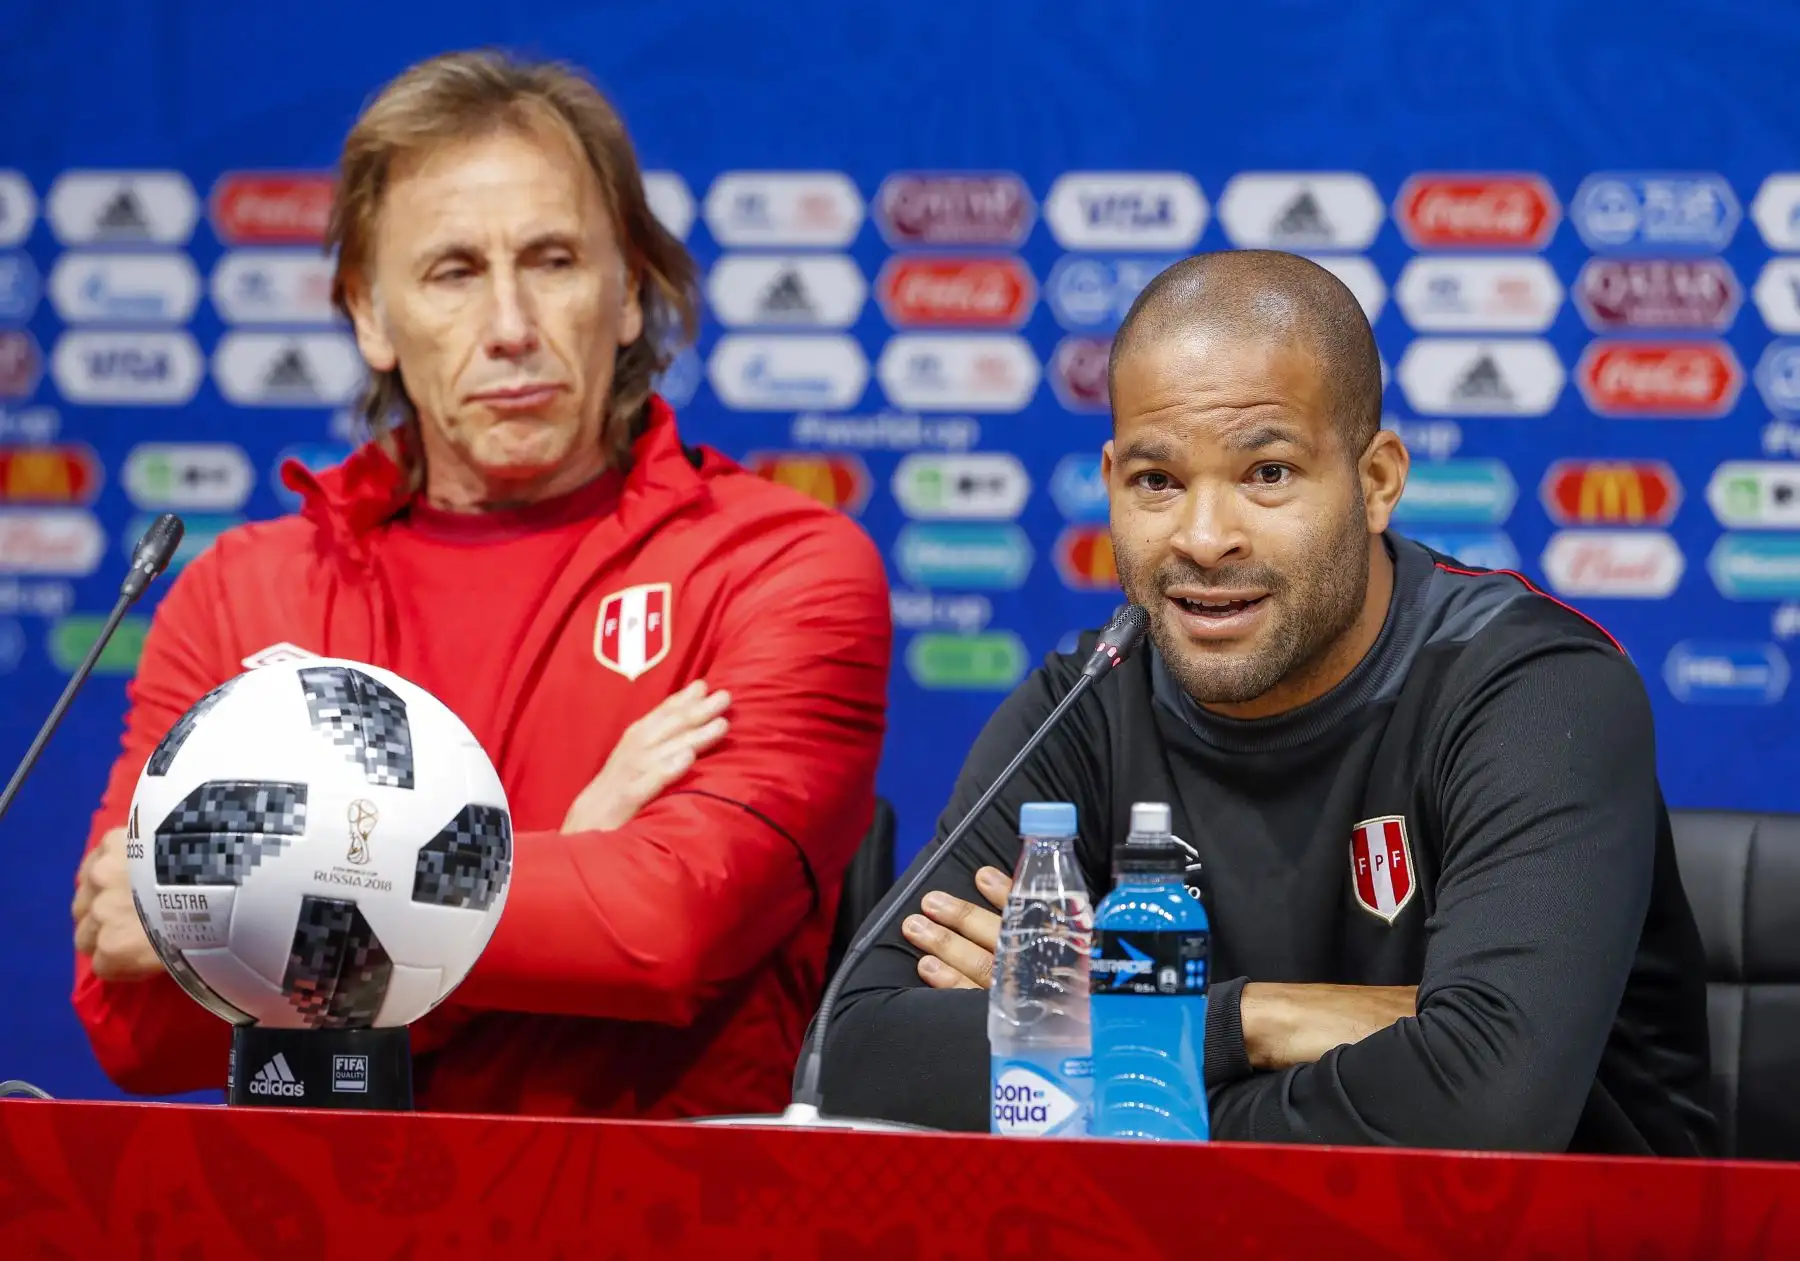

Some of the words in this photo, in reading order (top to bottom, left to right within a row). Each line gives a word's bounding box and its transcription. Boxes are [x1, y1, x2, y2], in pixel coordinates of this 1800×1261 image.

[1358, 850, 1401, 876] FPF
[313, 870, 361, 887] RUSSIA
[364, 878, 392, 891] 2018
[336, 1058, 365, 1071] FIFA
[249, 1079, 304, 1097] adidas
